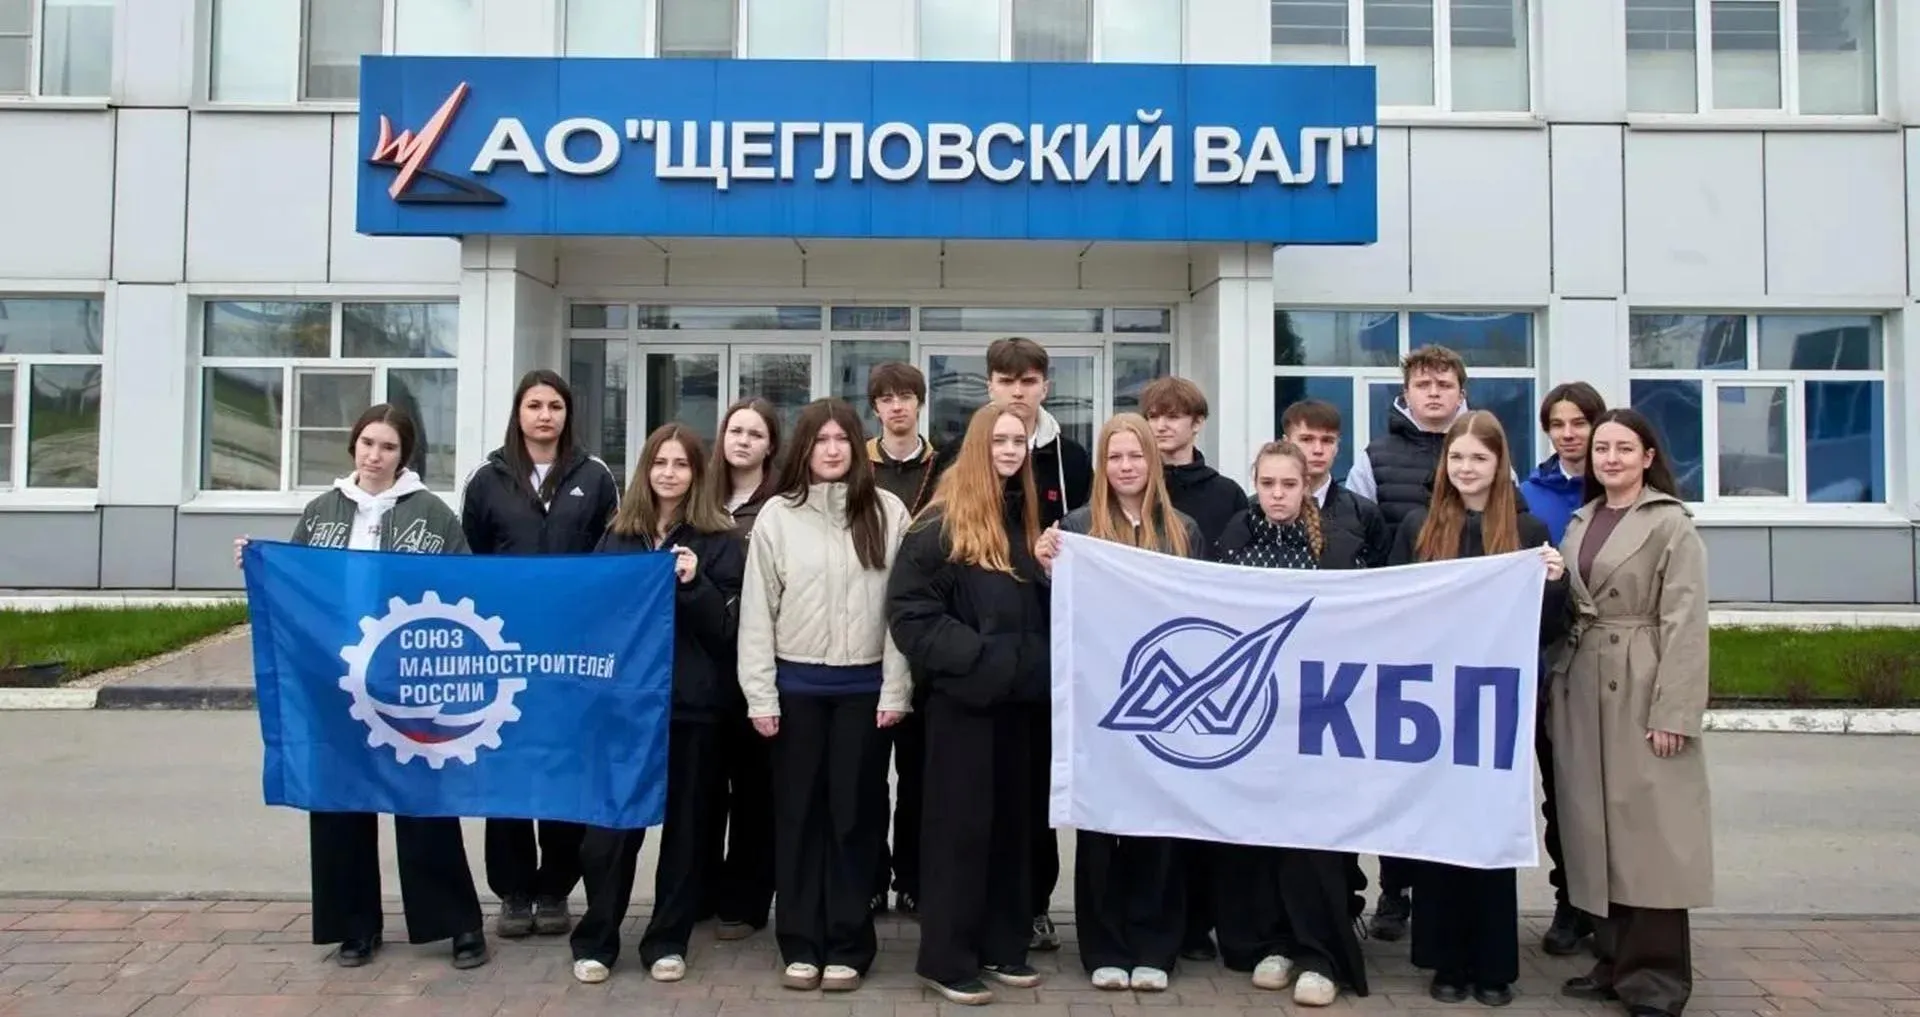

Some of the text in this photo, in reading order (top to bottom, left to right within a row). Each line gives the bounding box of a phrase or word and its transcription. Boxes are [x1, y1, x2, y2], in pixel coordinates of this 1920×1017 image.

[470, 108, 1374, 191] АО "ЩЕГЛОВСКИЙ ВАЛ"
[400, 629, 464, 650] СОЮЗ
[399, 653, 616, 679] МАШИНОСТРОИТЕЛЕЙ
[400, 684, 485, 704] РОССИИ
[1298, 660, 1521, 771] КБП
